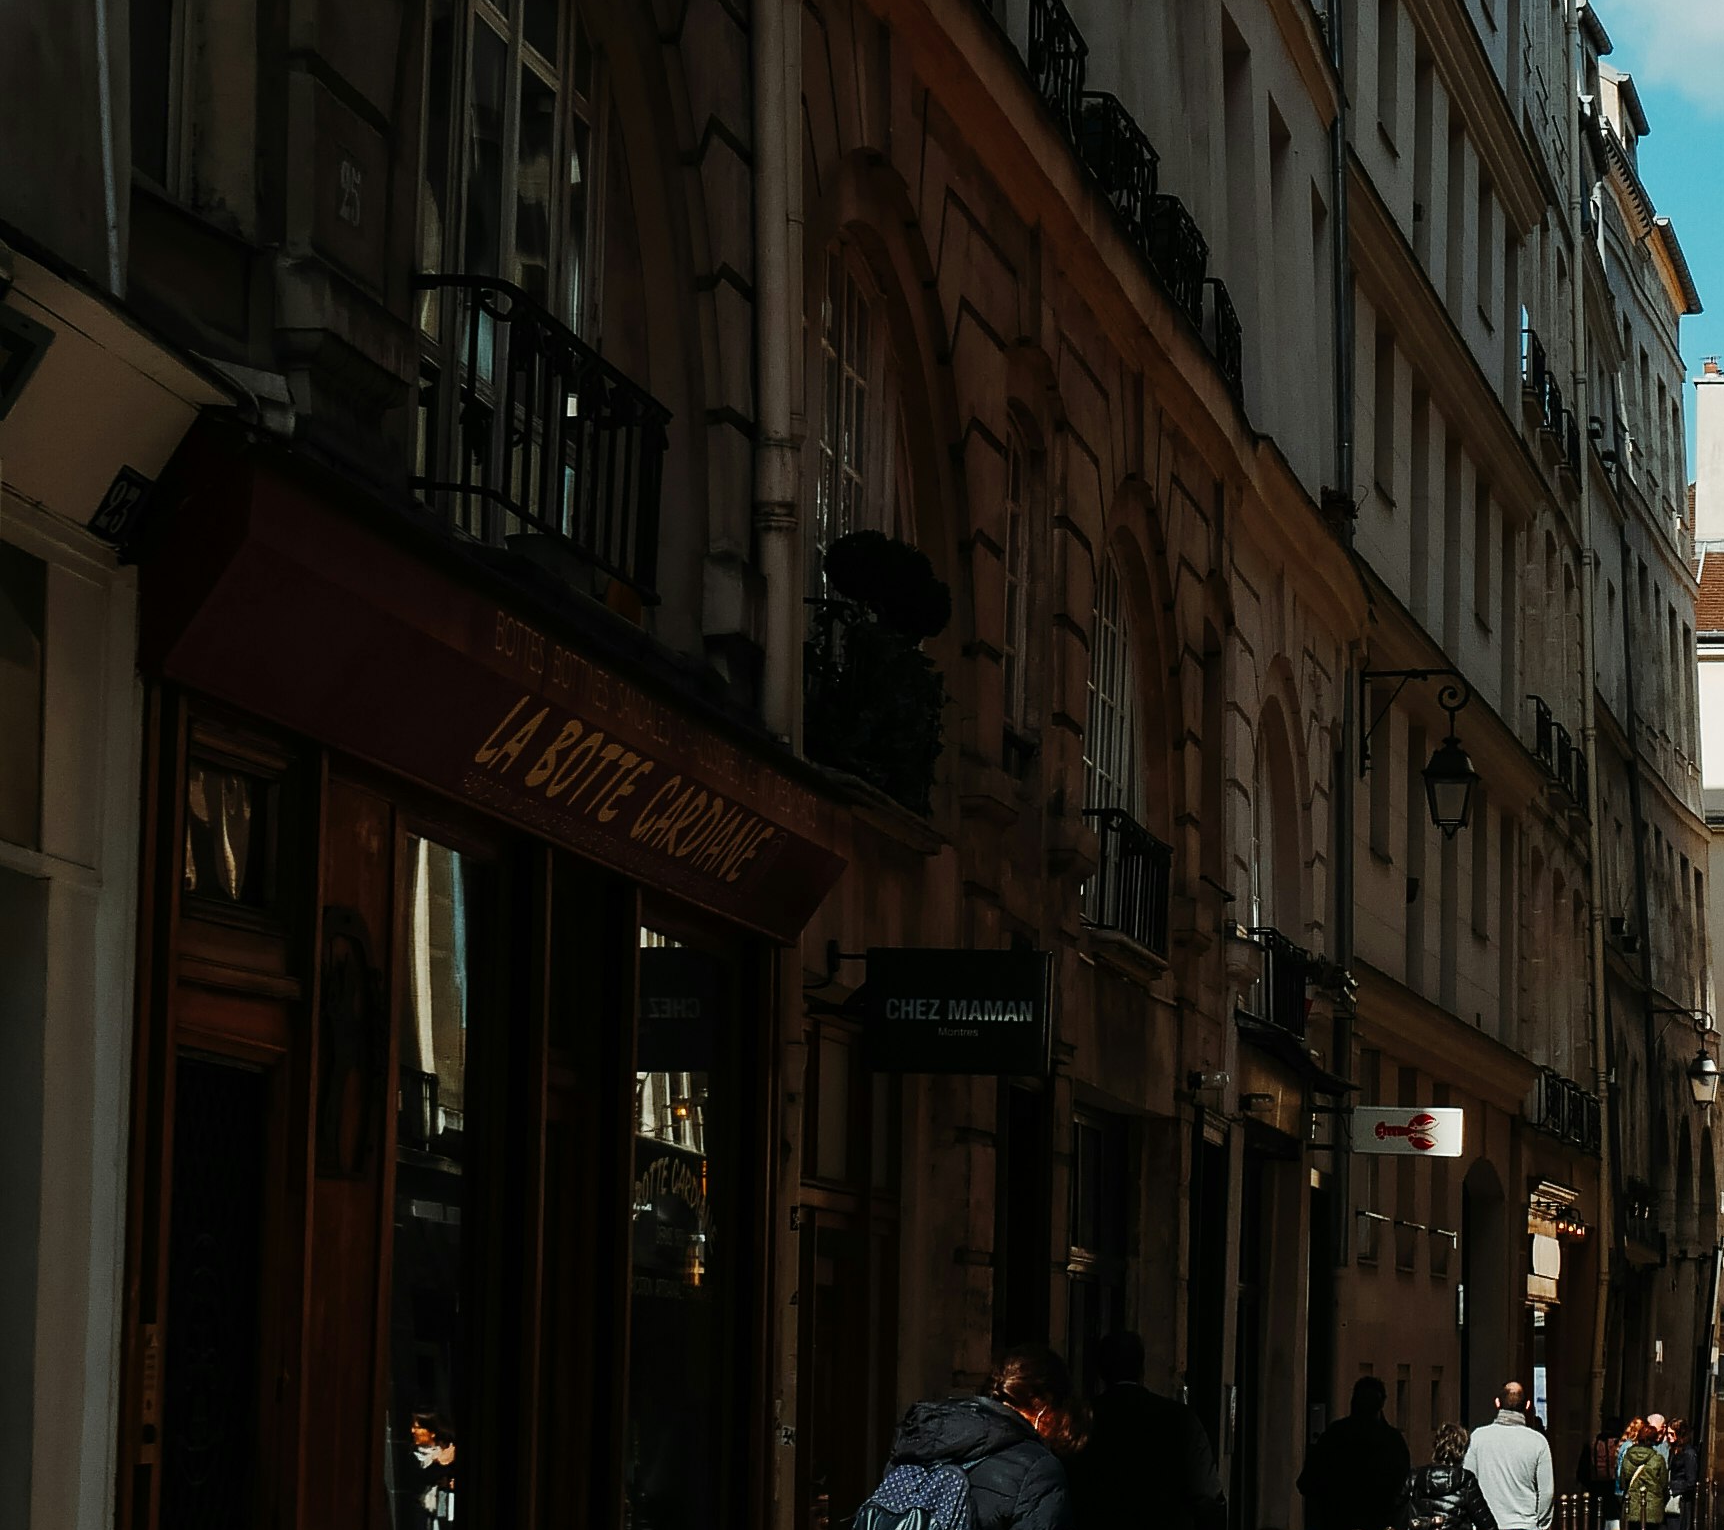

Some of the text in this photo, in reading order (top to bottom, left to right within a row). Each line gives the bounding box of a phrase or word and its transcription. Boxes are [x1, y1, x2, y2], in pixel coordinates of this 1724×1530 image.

[94, 480, 142, 534] 23
[495, 609, 546, 675] BOTTES
[475, 695, 551, 774] LA
[524, 719, 655, 822] BOTTE
[885, 997, 1034, 1023] CHEZ MAMAN
[937, 1026, 980, 1038] Montres
